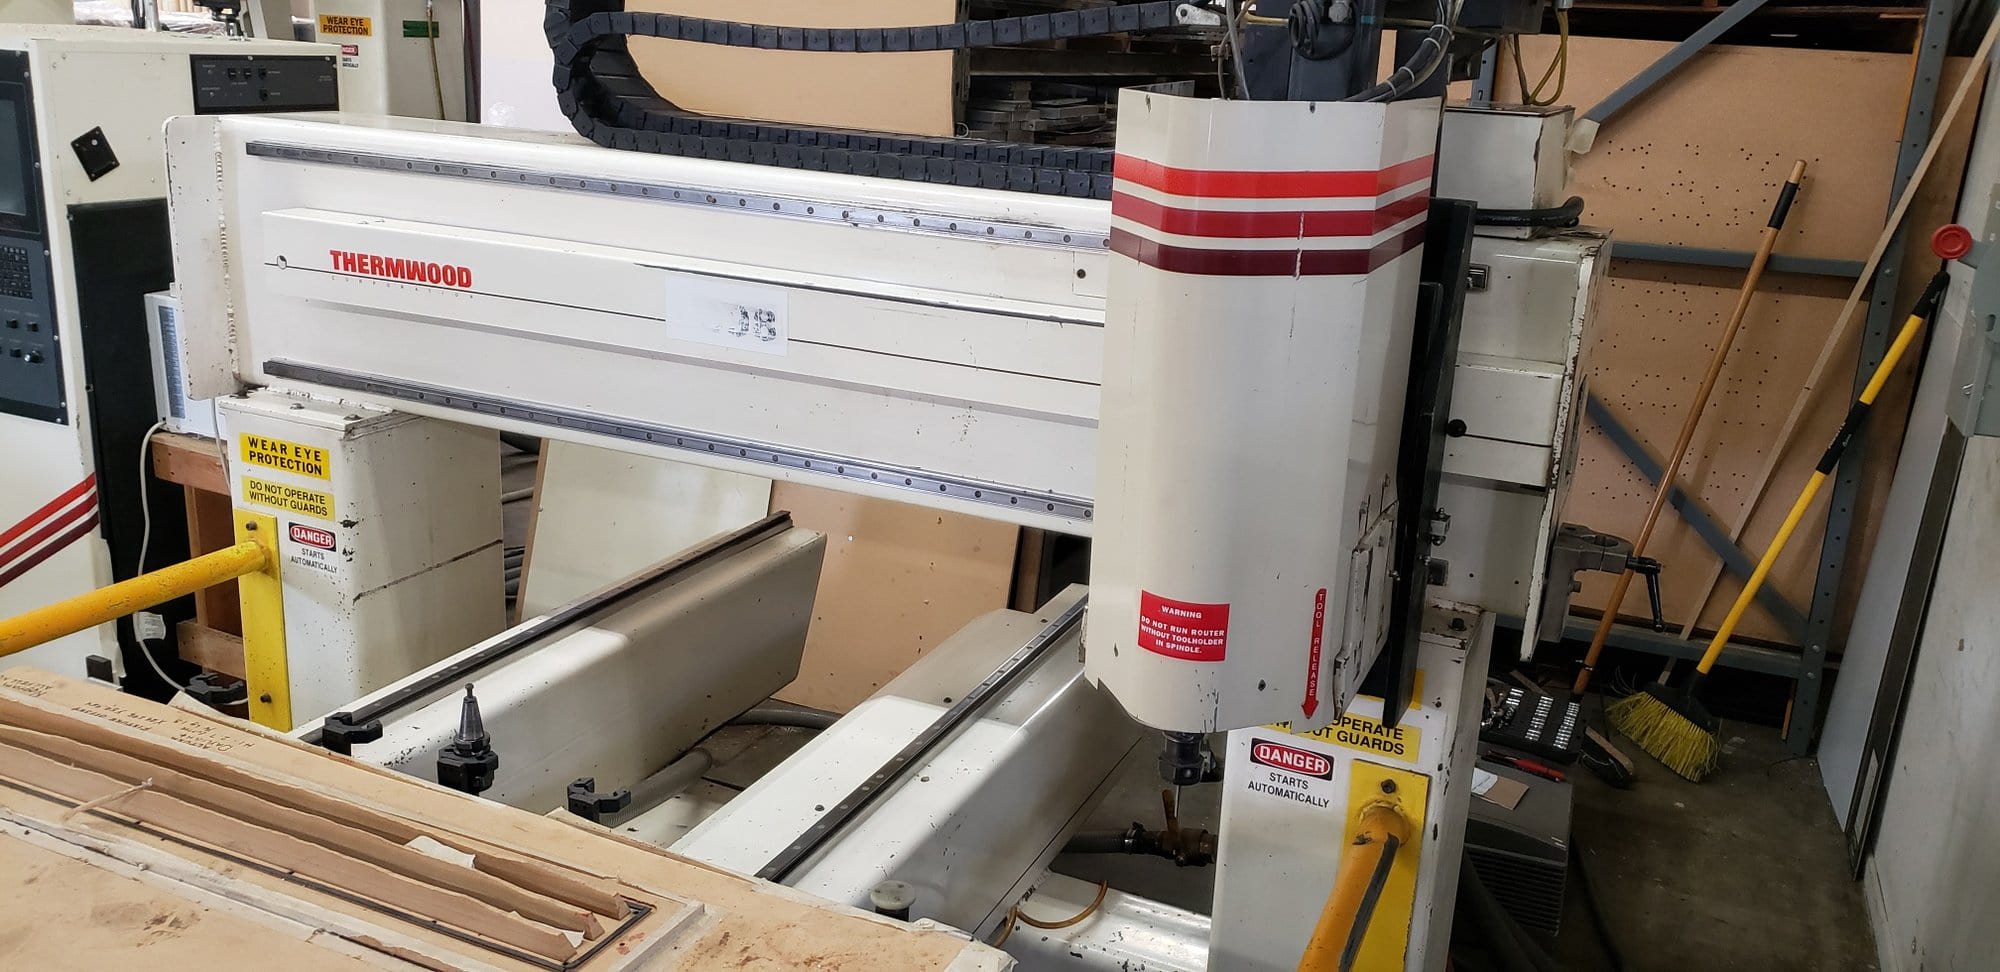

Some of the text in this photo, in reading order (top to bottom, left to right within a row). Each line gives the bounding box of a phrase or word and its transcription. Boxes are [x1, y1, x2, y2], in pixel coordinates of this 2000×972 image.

[323, 25, 369, 35] PROTECTION
[326, 16, 364, 26] WEAR EYE
[329, 250, 472, 288] THERMWOOD
[248, 436, 322, 461] WEAR EYE
[249, 450, 322, 475] PROTECTION
[249, 490, 328, 516] WITHOUT GUARDS
[250, 480, 326, 505] DO NOT OPERATE
[294, 527, 332, 546] DANGER
[291, 556, 338, 573] AUTOMATICALLY
[301, 548, 325, 560] STARTS
[1161, 605, 1202, 619] WARNING
[1141, 615, 1225, 637] DO NOT RUN ROUTER
[1141, 624, 1224, 646] WITHOUT TOOLHOLDER
[1156, 639, 1202, 654] IN SPINDLE.
[1309, 593, 1324, 697] TOOL RELEASE
[1336, 730, 1405, 756] GUARDS
[1259, 745, 1325, 773] DANGER
[1269, 772, 1309, 790] STARTS
[1247, 780, 1330, 809] AUTOMATICALLY
